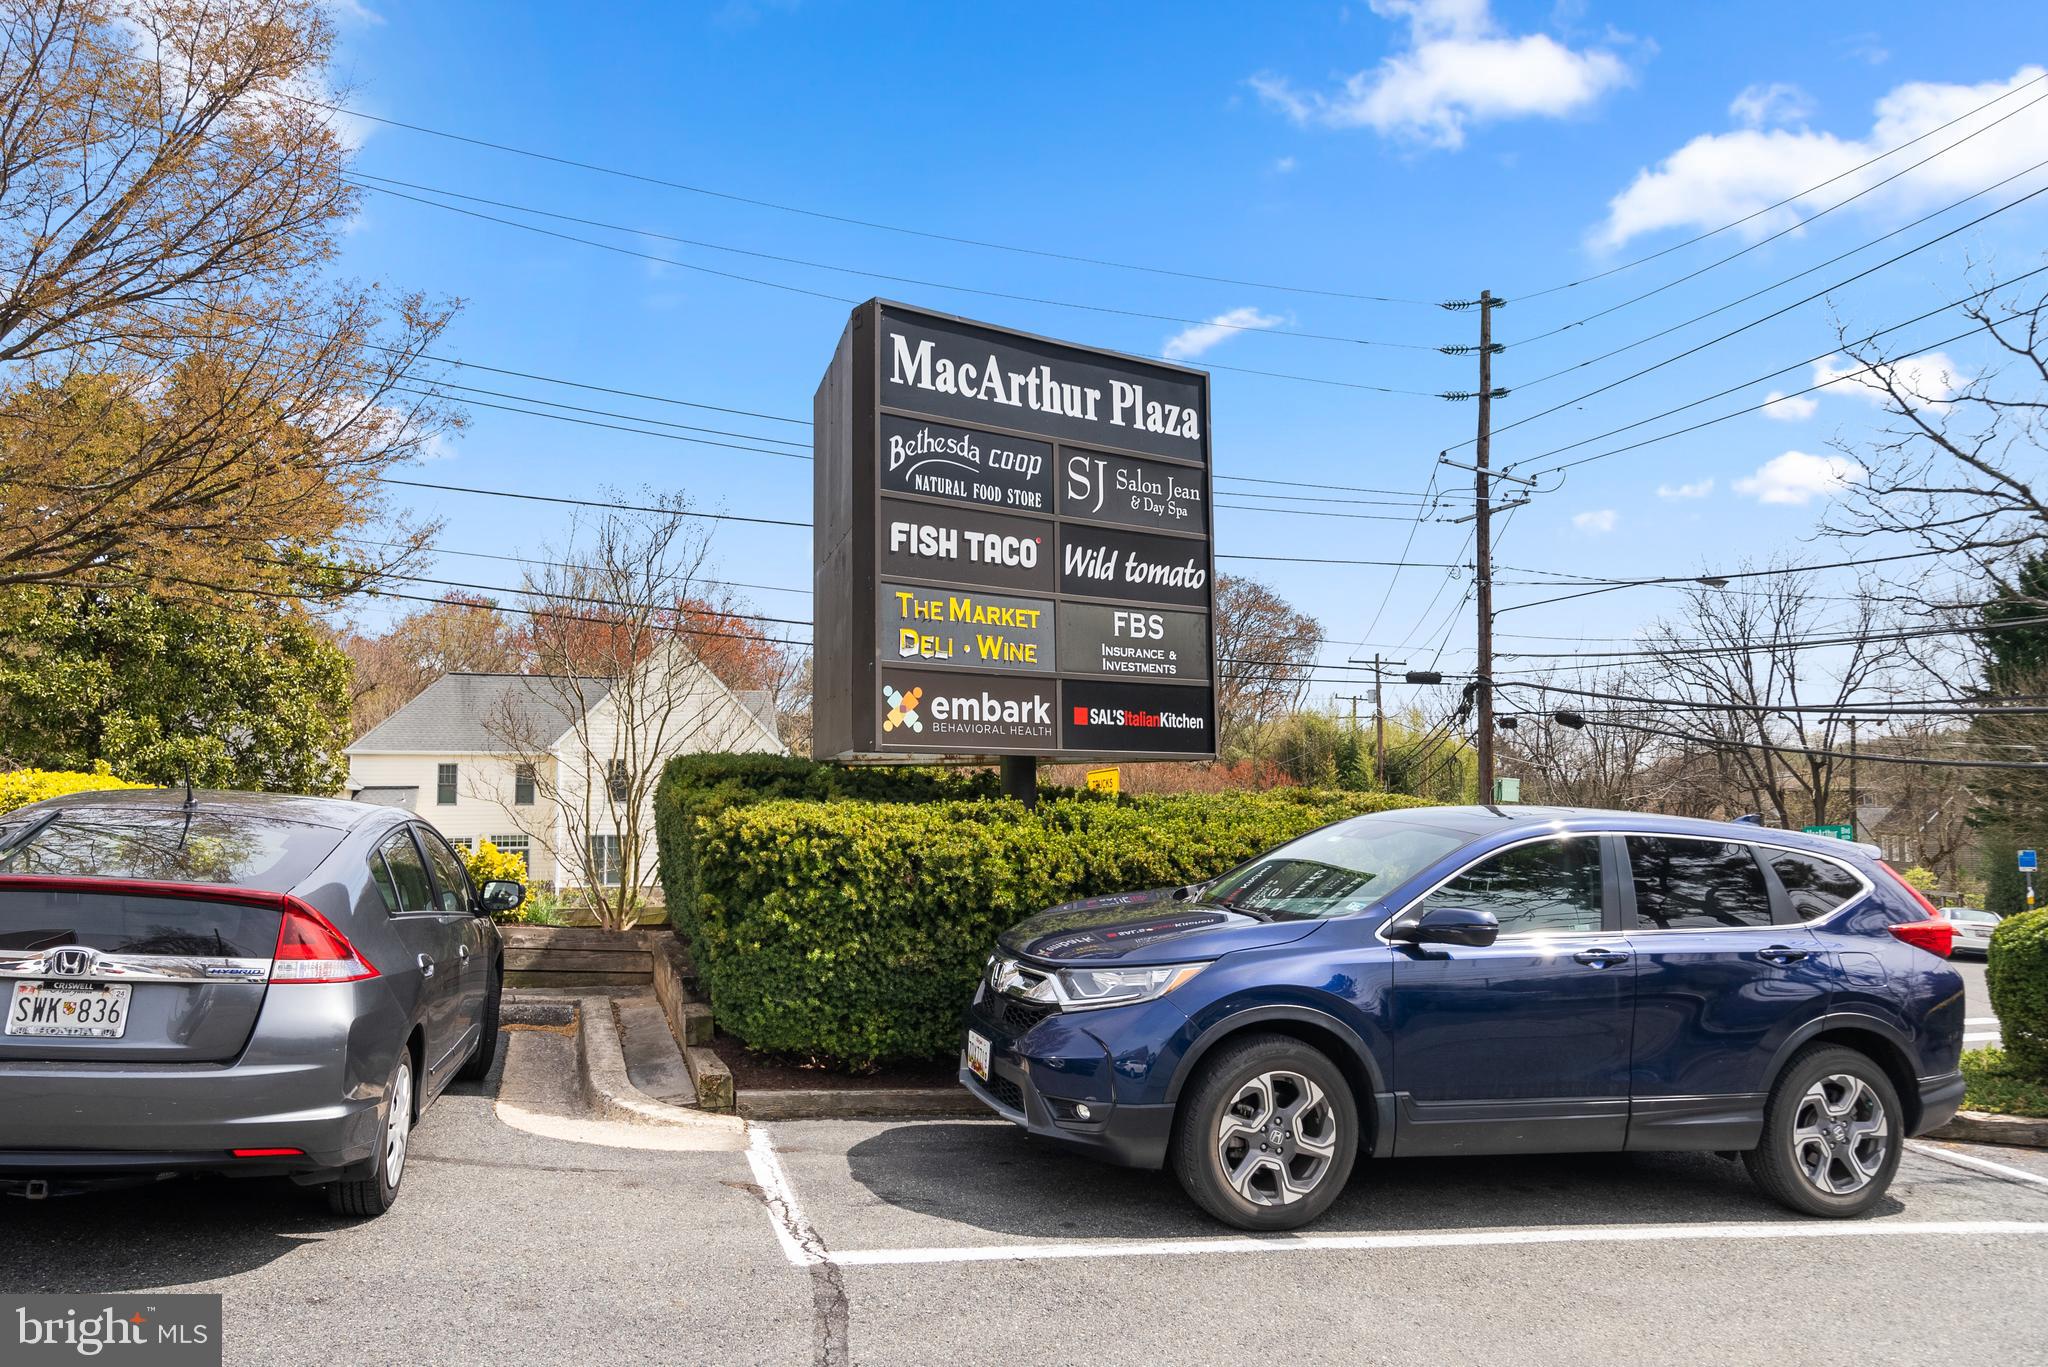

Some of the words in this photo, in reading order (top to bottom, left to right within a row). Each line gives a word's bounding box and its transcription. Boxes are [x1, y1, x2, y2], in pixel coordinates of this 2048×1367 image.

[889, 333, 1100, 421] MacArthur
[1108, 380, 1200, 440] Plaza
[889, 427, 980, 471] Bethesda
[915, 474, 967, 498] NATURAL
[973, 482, 1002, 502] FOOD
[1007, 489, 1042, 508] STORE
[1067, 456, 1108, 513] SJ
[1116, 469, 1163, 496] Salon
[1165, 476, 1200, 501] Jean
[1131, 495, 1139, 508] &
[1143, 497, 1165, 515] Day
[1167, 501, 1188, 518] Spa
[891, 521, 957, 559] FISH
[964, 530, 1038, 569] TACO
[1064, 543, 1118, 583] Wild
[1124, 549, 1206, 590] tomato
[1113, 612, 1164, 640] FBS
[1101, 643, 1165, 659] INSURANCE
[1169, 649, 1177, 660] &
[1102, 658, 1177, 674] INVESTMENTS
[931, 692, 1051, 725] embark
[932, 722, 1006, 735] BEHAVIORAL
[1009, 725, 1052, 736] HEALTH
[209, 968, 262, 976] HYBRID
[16, 997, 62, 1022] SWK
[78, 999, 120, 1023] 836
